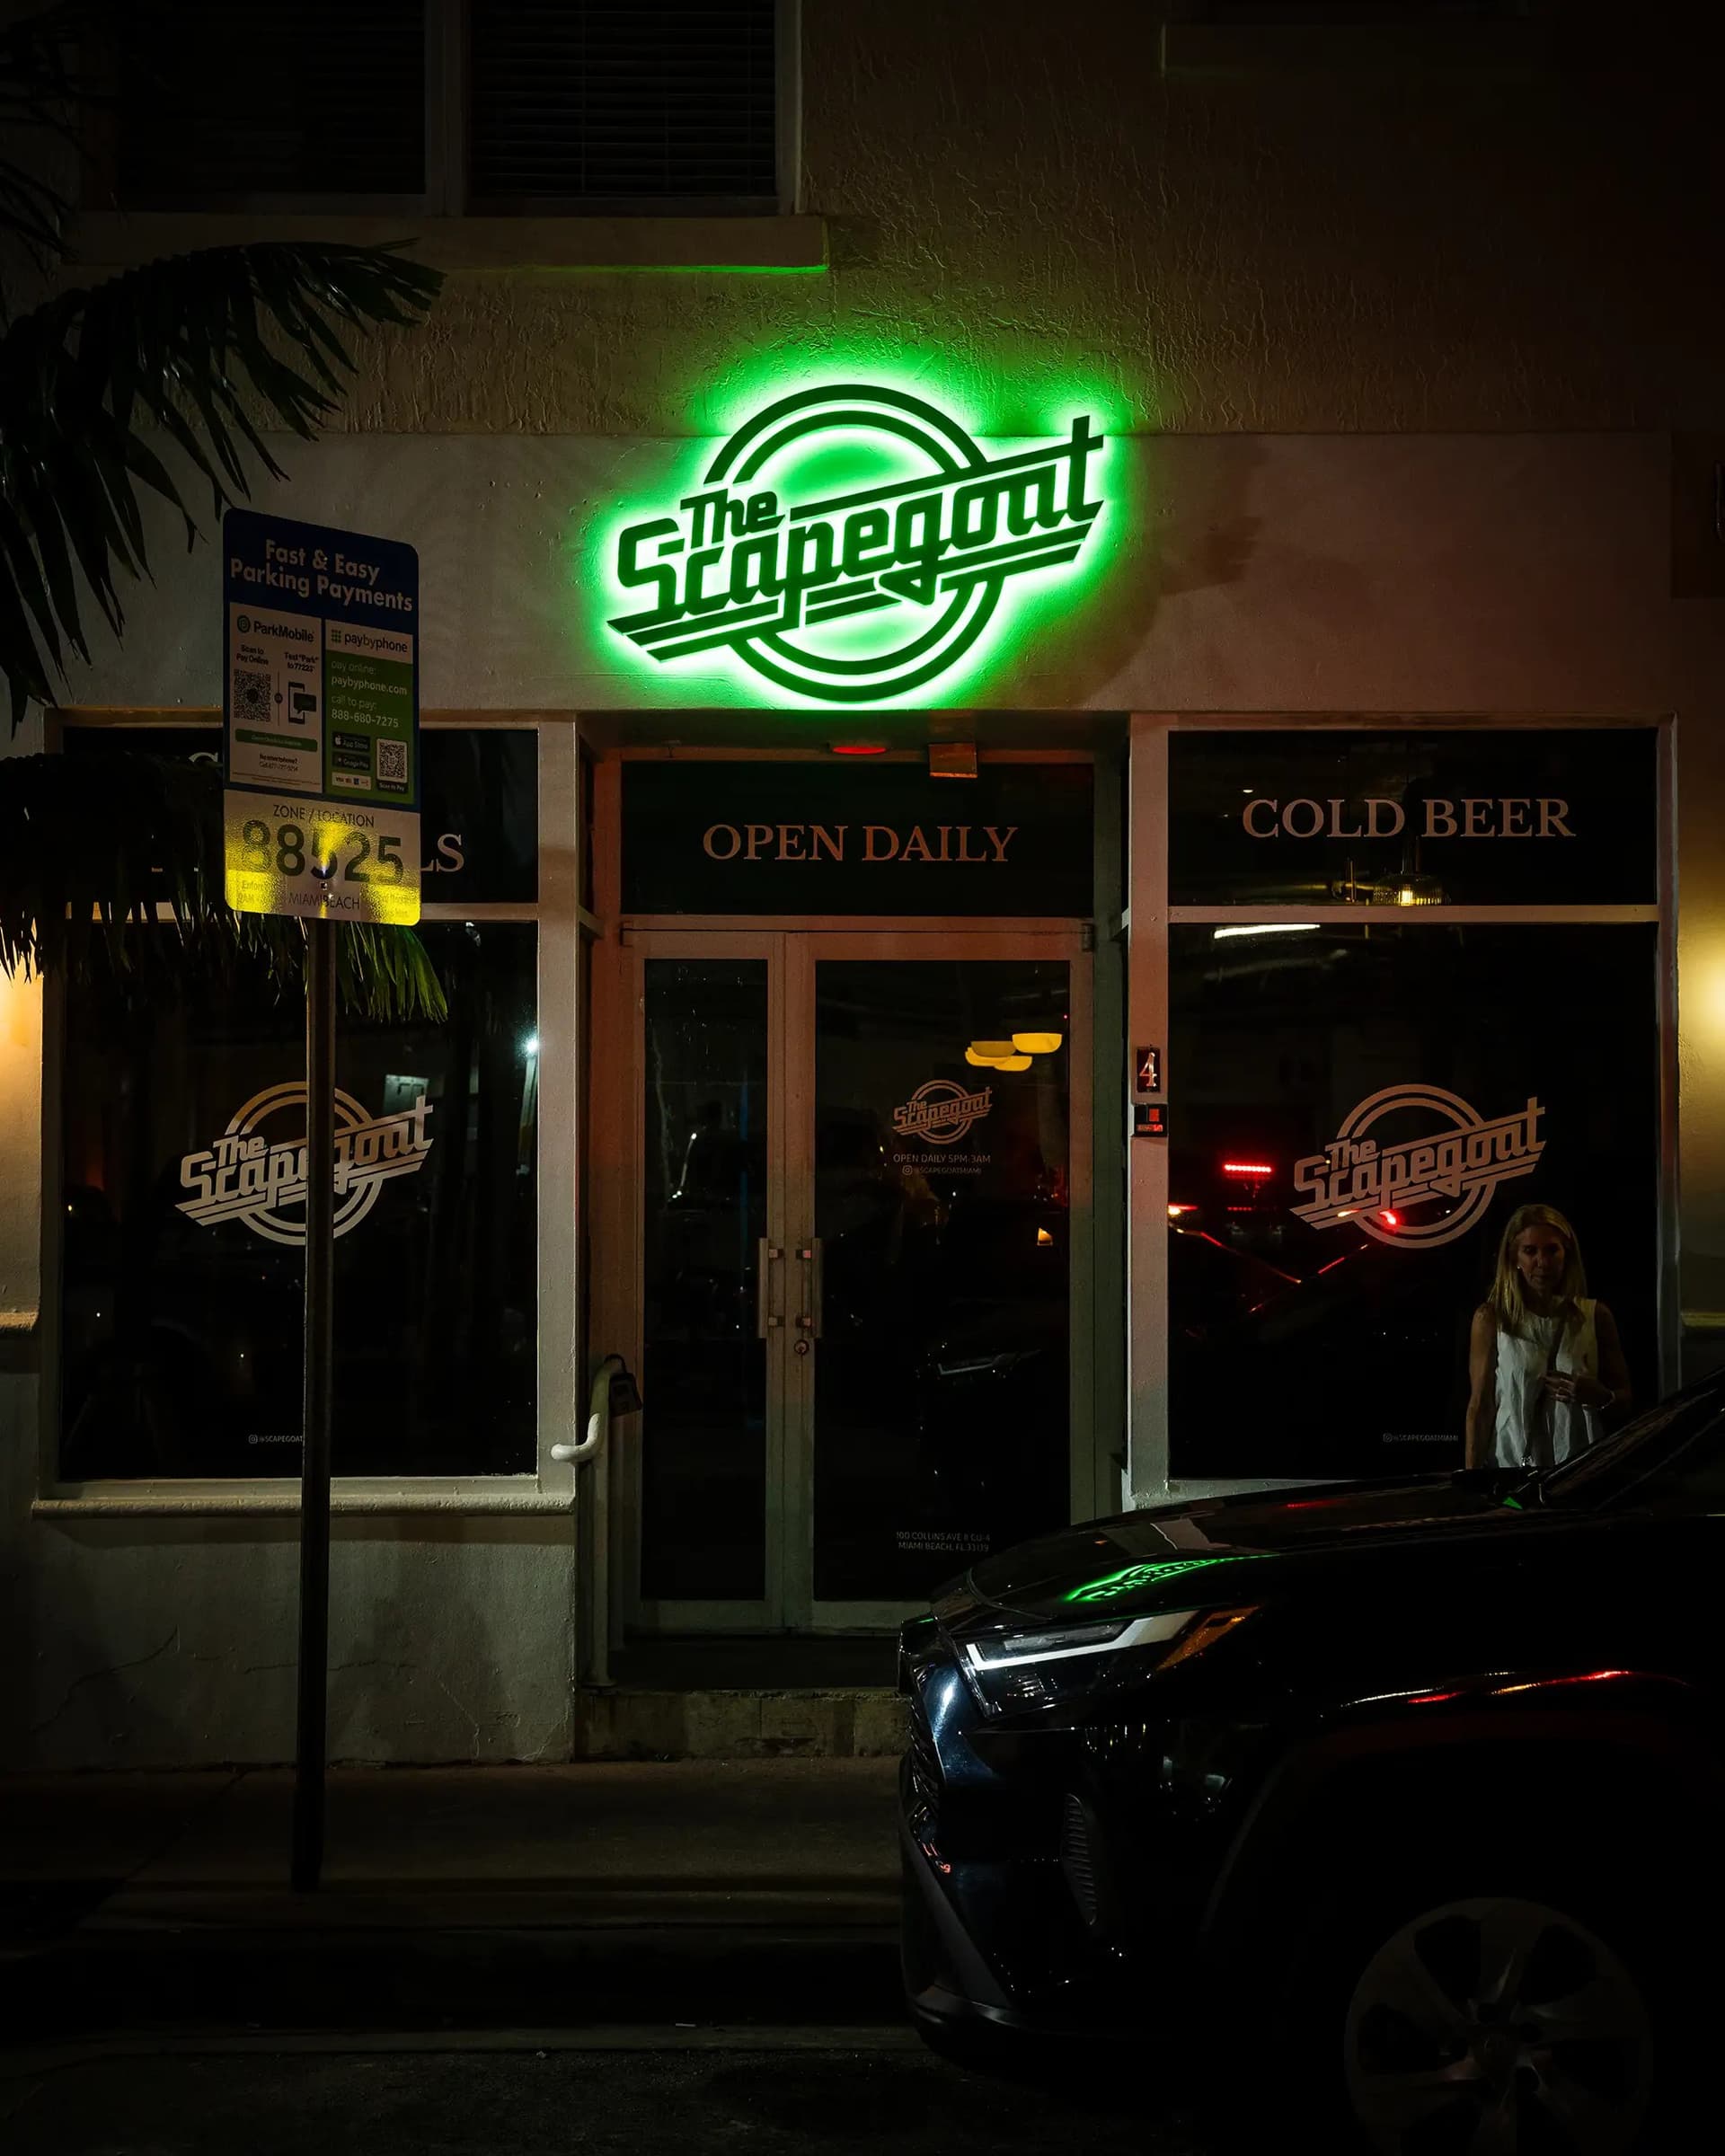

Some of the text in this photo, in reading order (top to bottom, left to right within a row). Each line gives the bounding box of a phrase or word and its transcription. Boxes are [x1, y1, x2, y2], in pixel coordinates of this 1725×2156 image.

[607, 415, 1104, 631] Scapegoat
[680, 488, 785, 549] The
[265, 539, 380, 585] Fast & Easy
[230, 557, 413, 612] Parking Payments
[253, 621, 314, 642] ParkMobile
[344, 633, 408, 652] paybyphone
[332, 676, 408, 696] paybyphone.com
[332, 695, 346, 705] call
[348, 696, 357, 707] to
[332, 708, 400, 728] 888-680-7275
[273, 804, 375, 827] ZONE / LOCATION
[1242, 798, 1577, 839] COLD BEER
[243, 819, 405, 885] 88525
[702, 824, 1020, 862] OPEN DAILY
[288, 892, 359, 910] MIAMI BEACH
[1139, 1052, 1157, 1087] 4
[892, 1086, 993, 1131] Scapegoat
[907, 1100, 928, 1113] The
[213, 1135, 270, 1167] The
[893, 1153, 918, 1162] OPEN
[921, 1153, 946, 1163] DAILY
[1289, 1096, 1547, 1210] Scapegoat
[1324, 1138, 1380, 1170] The
[912, 1532, 946, 1541] COLLINS
